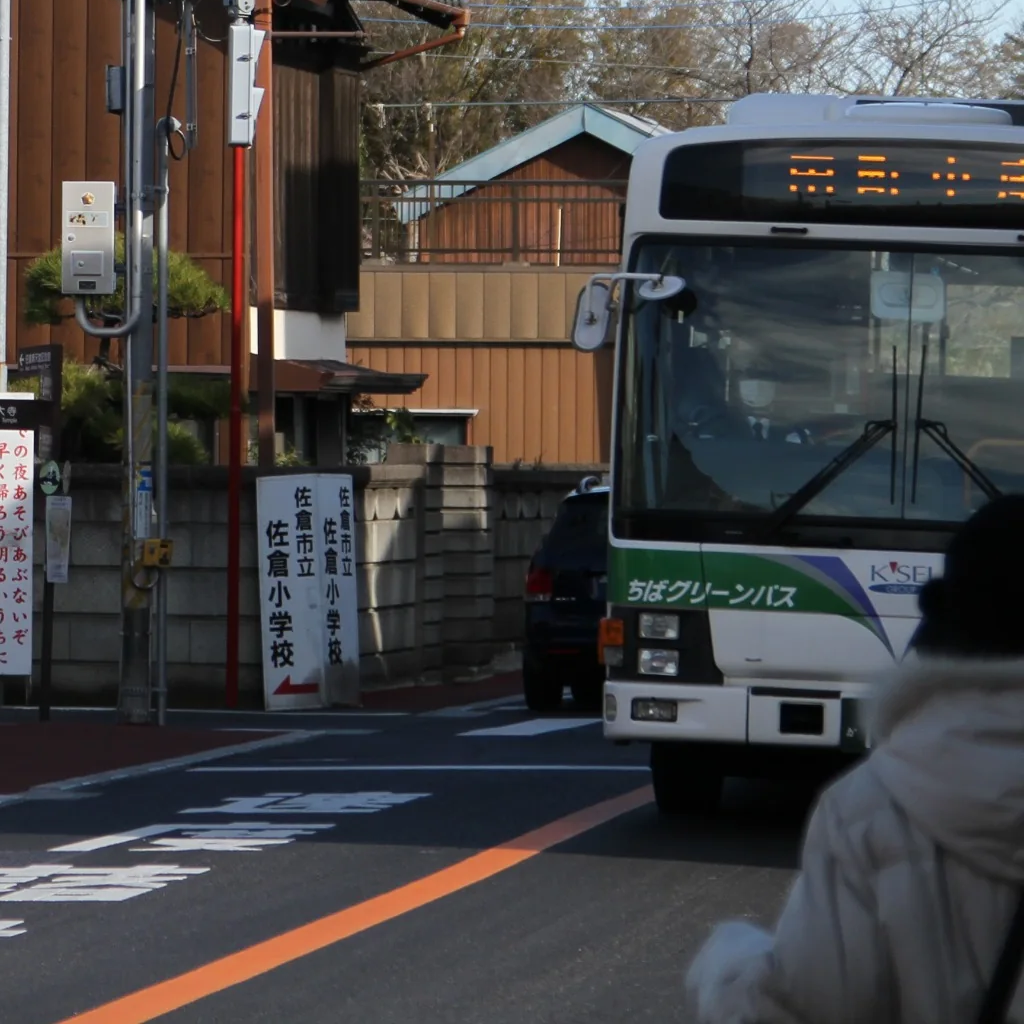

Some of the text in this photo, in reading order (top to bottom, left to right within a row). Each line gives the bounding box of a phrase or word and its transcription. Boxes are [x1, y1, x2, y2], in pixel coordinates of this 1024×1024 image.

[294, 486, 316, 578] 佐倉市立
[338, 486, 353, 577] 佐倉市立
[266, 520, 294, 668] 佐倉小学校
[323, 517, 342, 666] 佐倉小学校
[627, 578, 796, 609] ちばグリーンバス
